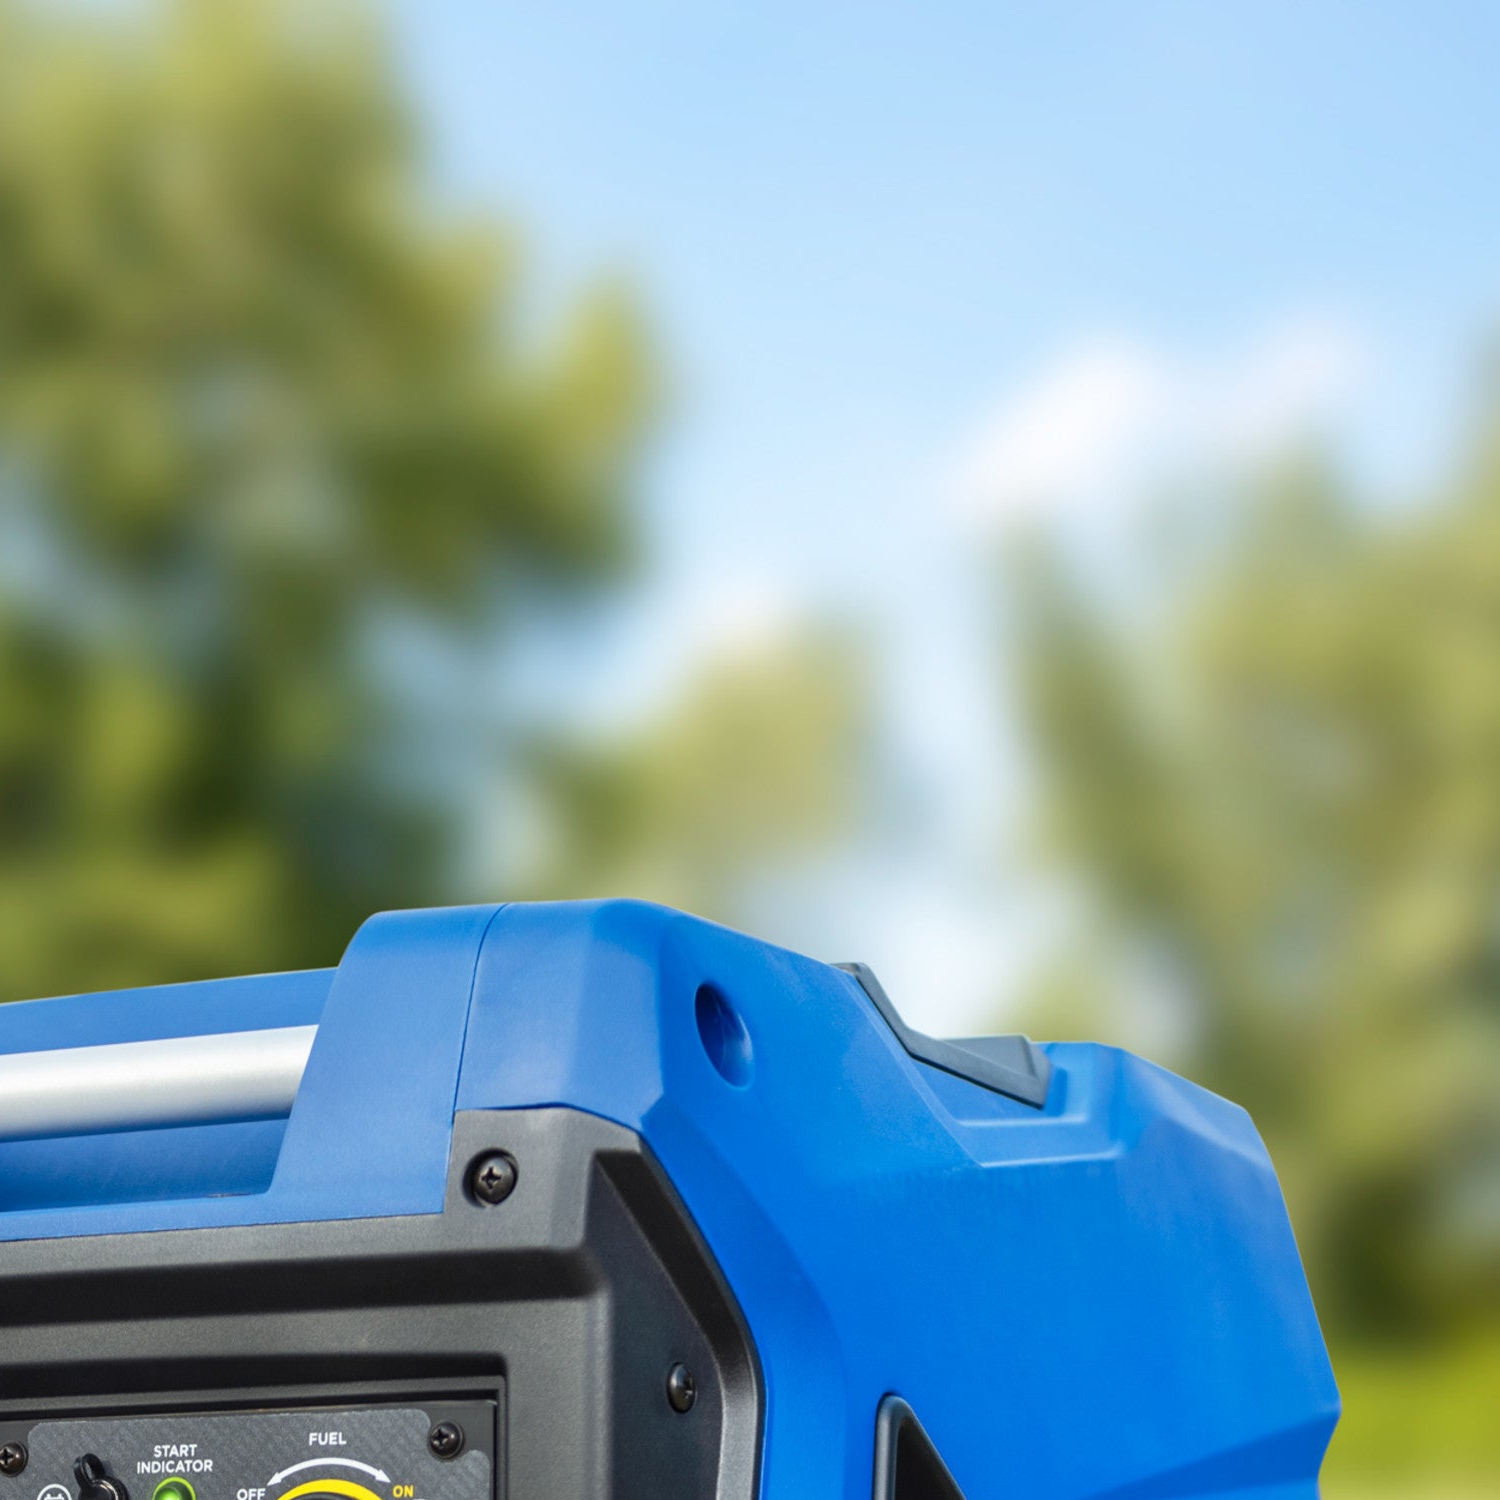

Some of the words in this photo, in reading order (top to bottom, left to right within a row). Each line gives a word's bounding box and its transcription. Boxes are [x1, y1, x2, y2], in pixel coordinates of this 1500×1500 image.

[309, 1432, 347, 1446] FUEL
[153, 1444, 197, 1458] START
[136, 1459, 213, 1474] INDICATOR
[392, 1485, 414, 1498] ON
